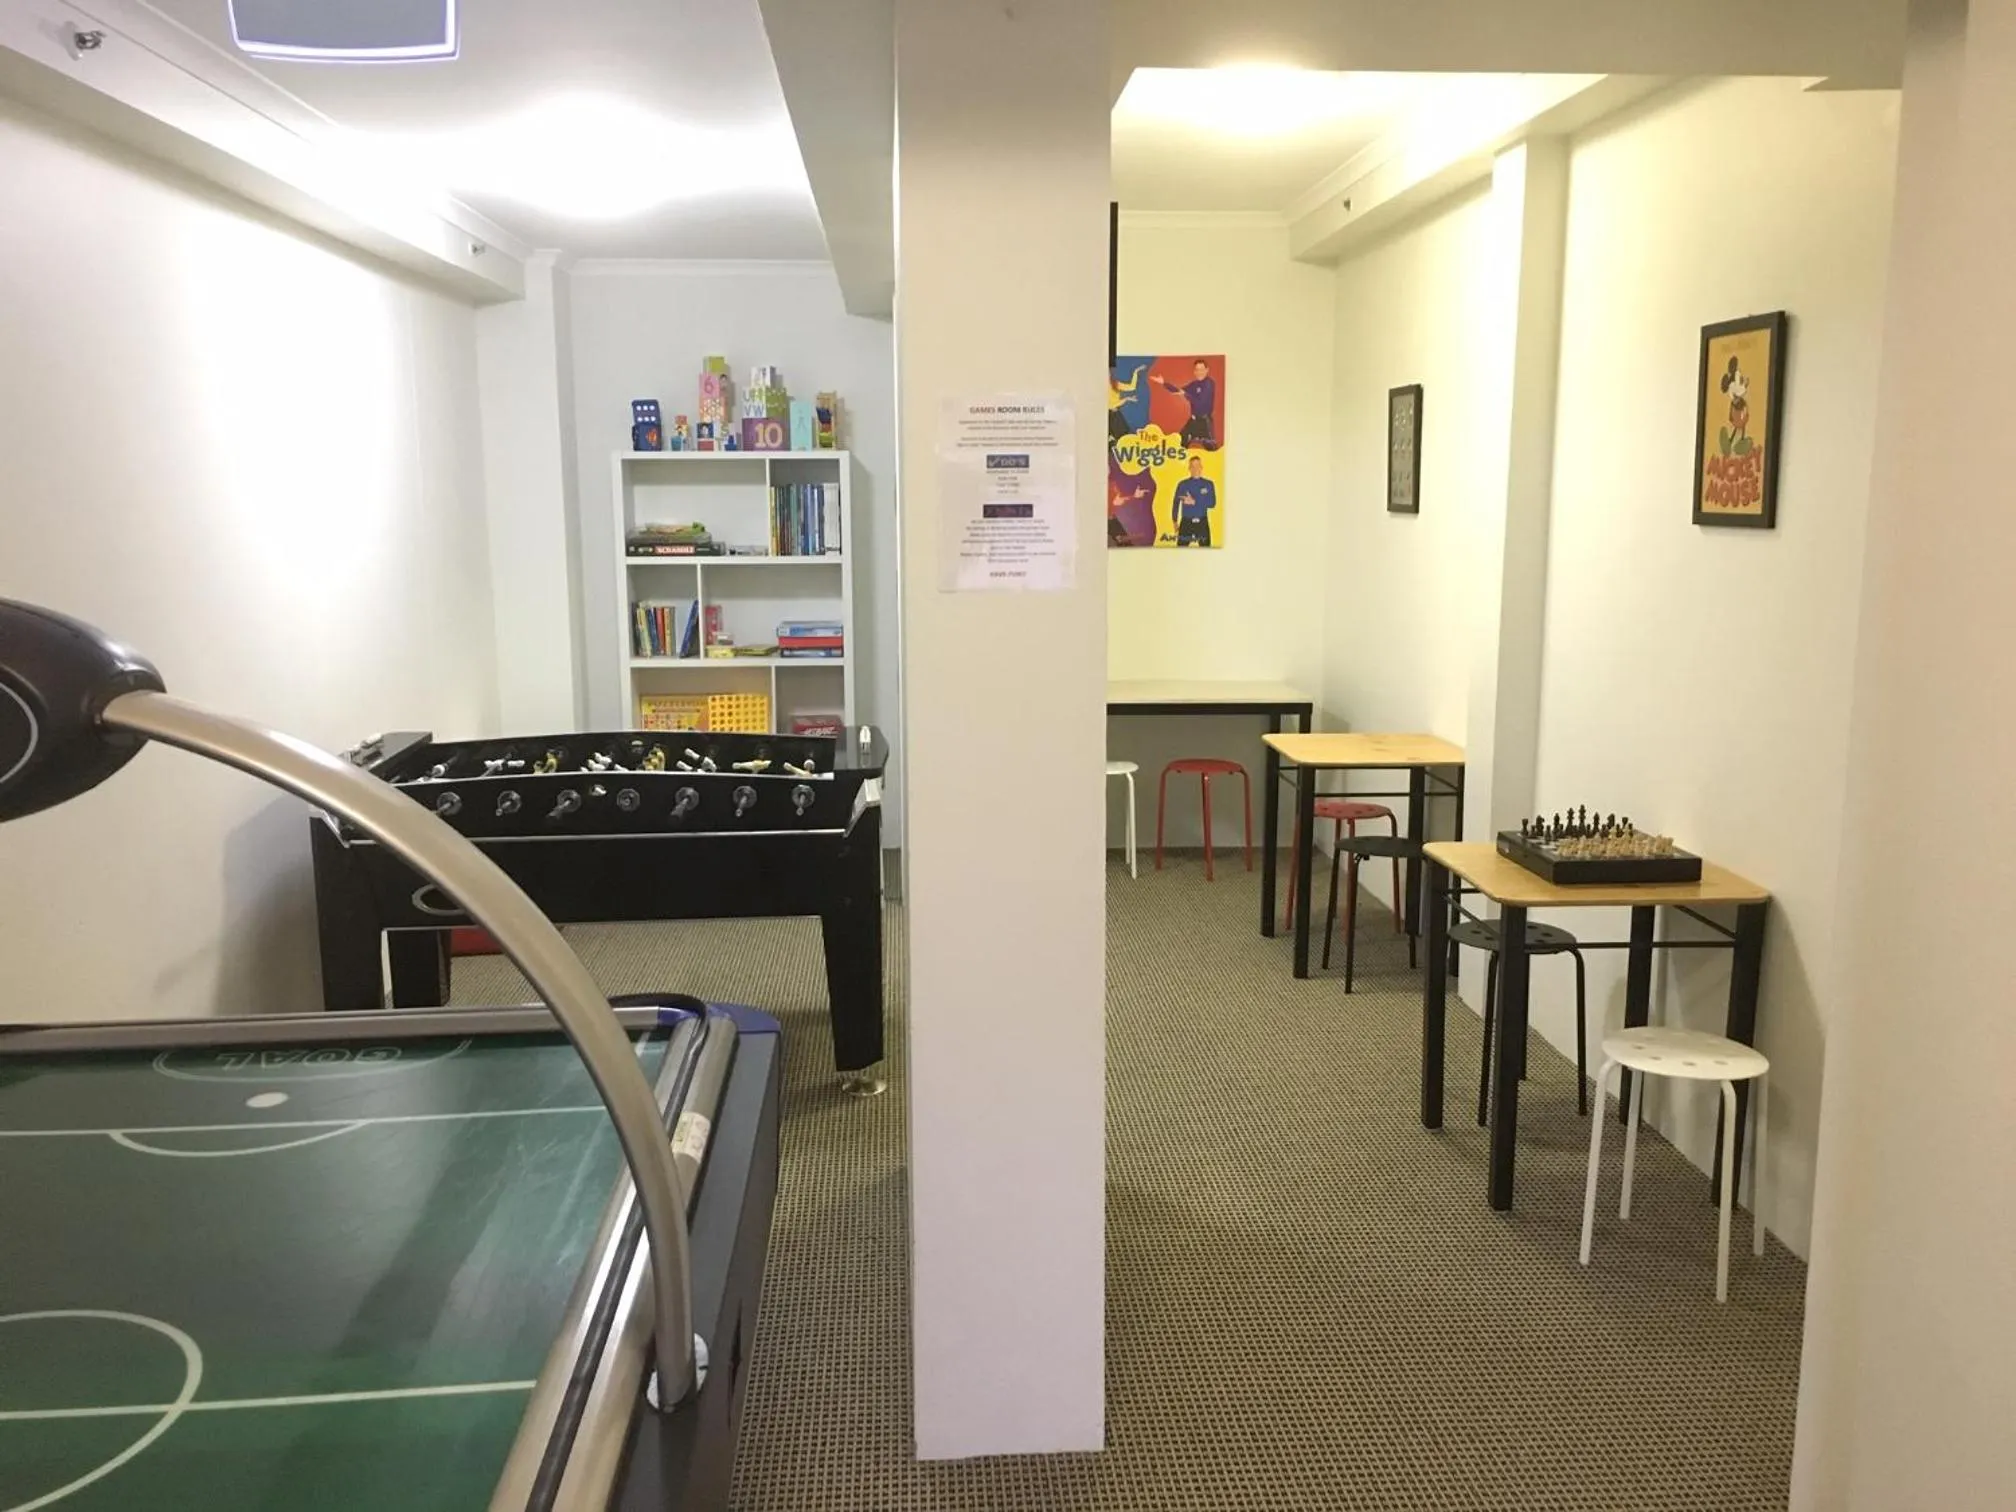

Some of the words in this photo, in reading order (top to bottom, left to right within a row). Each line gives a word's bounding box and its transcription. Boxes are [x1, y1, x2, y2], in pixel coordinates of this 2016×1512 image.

[703, 375, 714, 394] 6
[755, 422, 783, 447] 10
[1139, 430, 1159, 442] The
[1116, 440, 1187, 467] Wiggles
[1706, 445, 1762, 482] MICKEY
[1705, 476, 1760, 507] MOUSE
